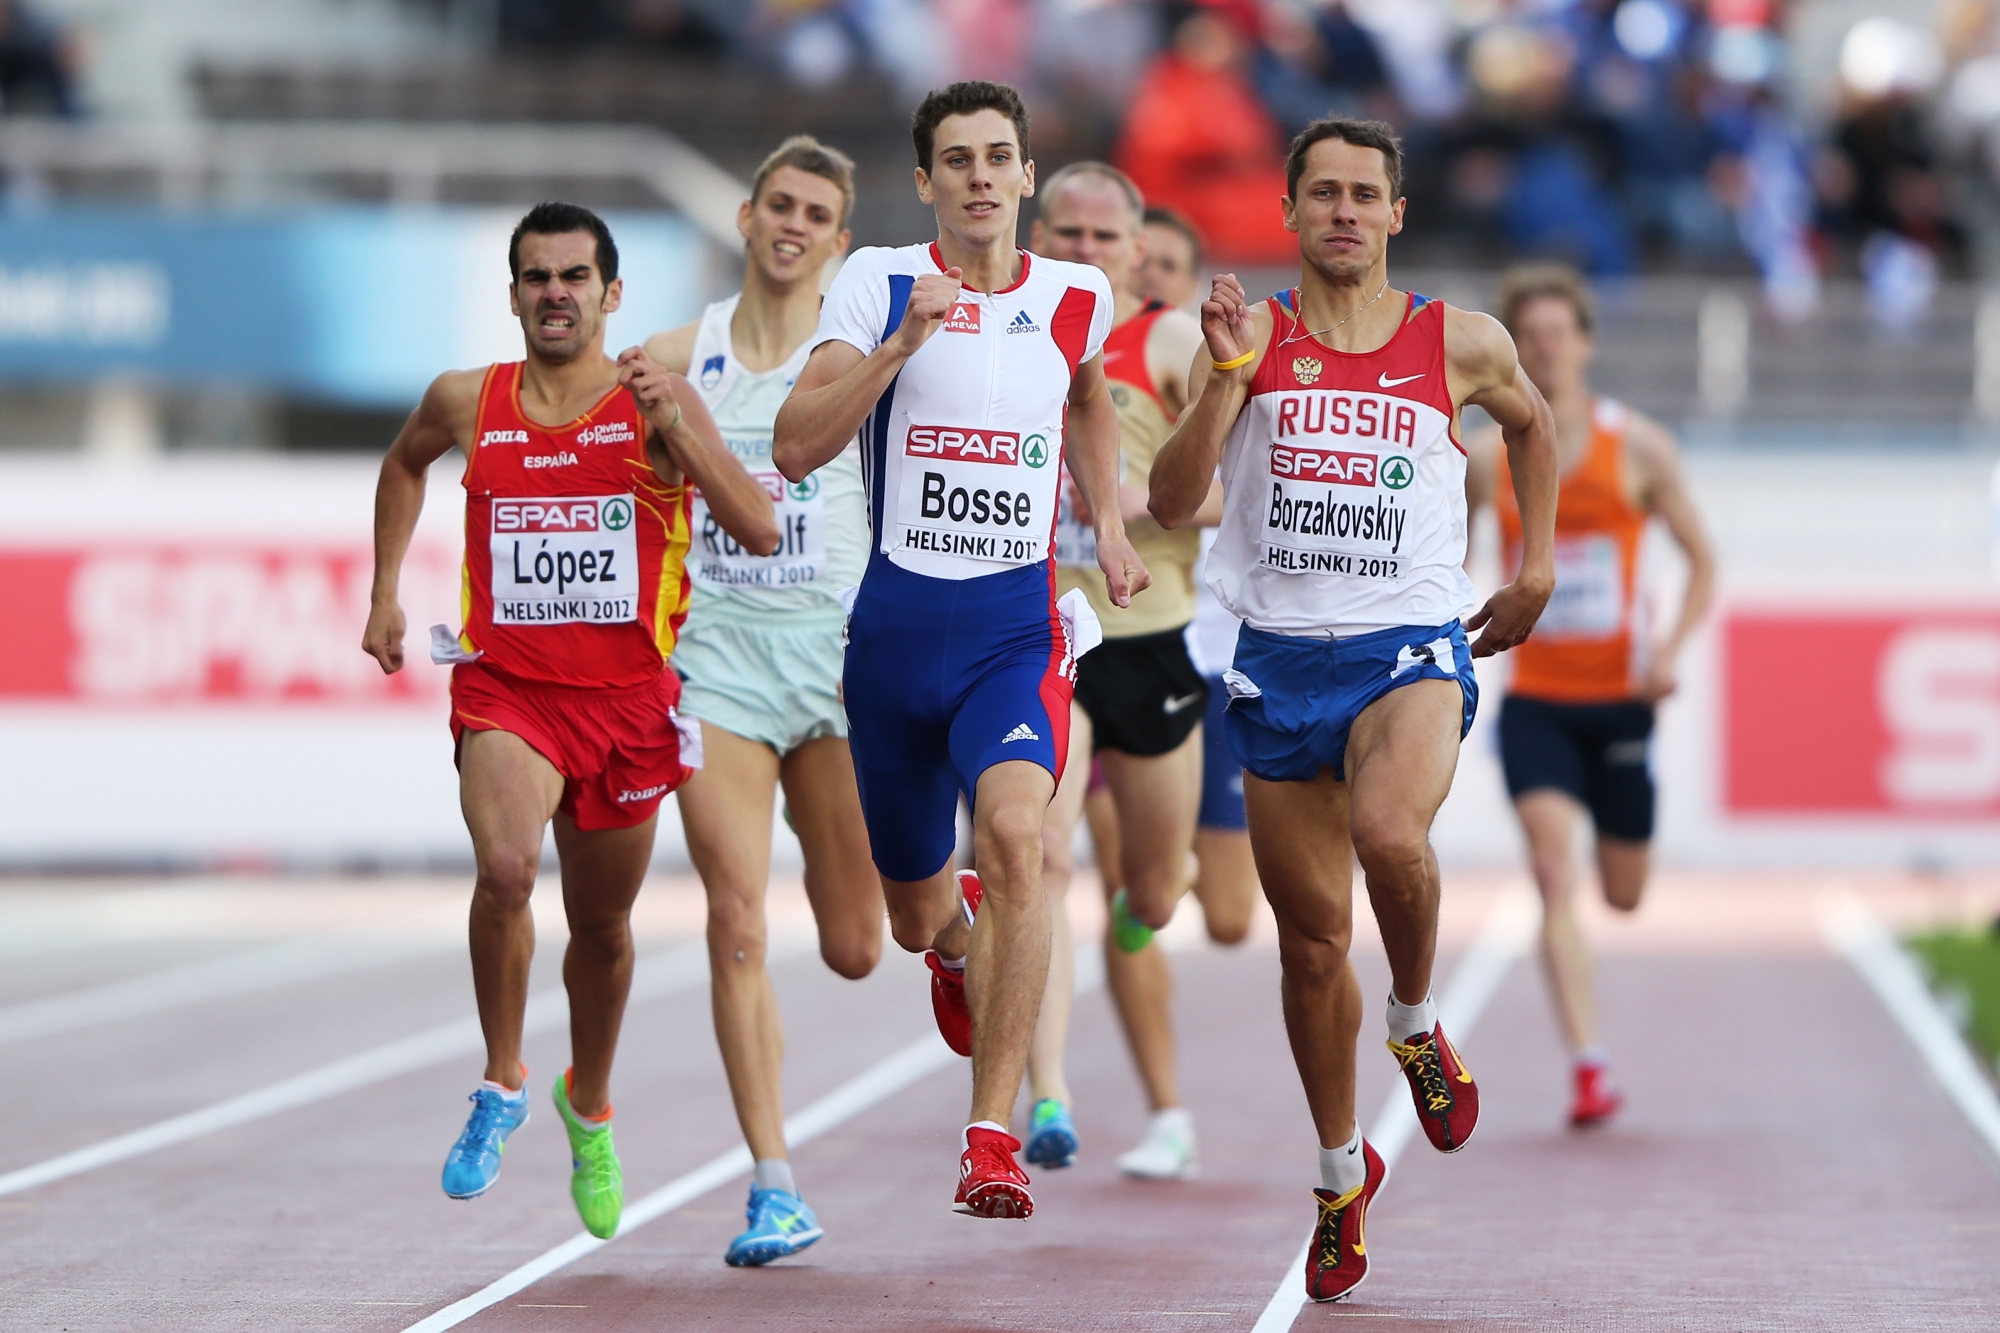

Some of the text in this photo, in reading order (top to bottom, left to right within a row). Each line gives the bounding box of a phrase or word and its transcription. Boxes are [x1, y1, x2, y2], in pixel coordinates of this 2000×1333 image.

[943, 321, 980, 331] AREVA
[1006, 324, 1041, 335] adidas
[594, 421, 628, 434] Divina
[1278, 396, 1416, 449] RUSSIA
[480, 429, 530, 447] Joma
[594, 431, 635, 445] Pastora
[910, 429, 1018, 462] SPAR
[523, 451, 579, 469] ESPAÑA
[1273, 448, 1375, 483] SPAR
[920, 471, 1032, 528] Bosse
[497, 504, 597, 530] SPAR
[1268, 482, 1407, 555] Borzakovskiy
[905, 529, 996, 558] HELSINKI
[513, 538, 616, 595] López
[699, 562, 816, 584] HELSINKI 2012
[1267, 547, 1399, 578] HELSINKI 2012
[502, 599, 631, 620] HELSINKI 2012
[1001, 732, 1040, 744] adidas
[617, 783, 668, 803] Joma
